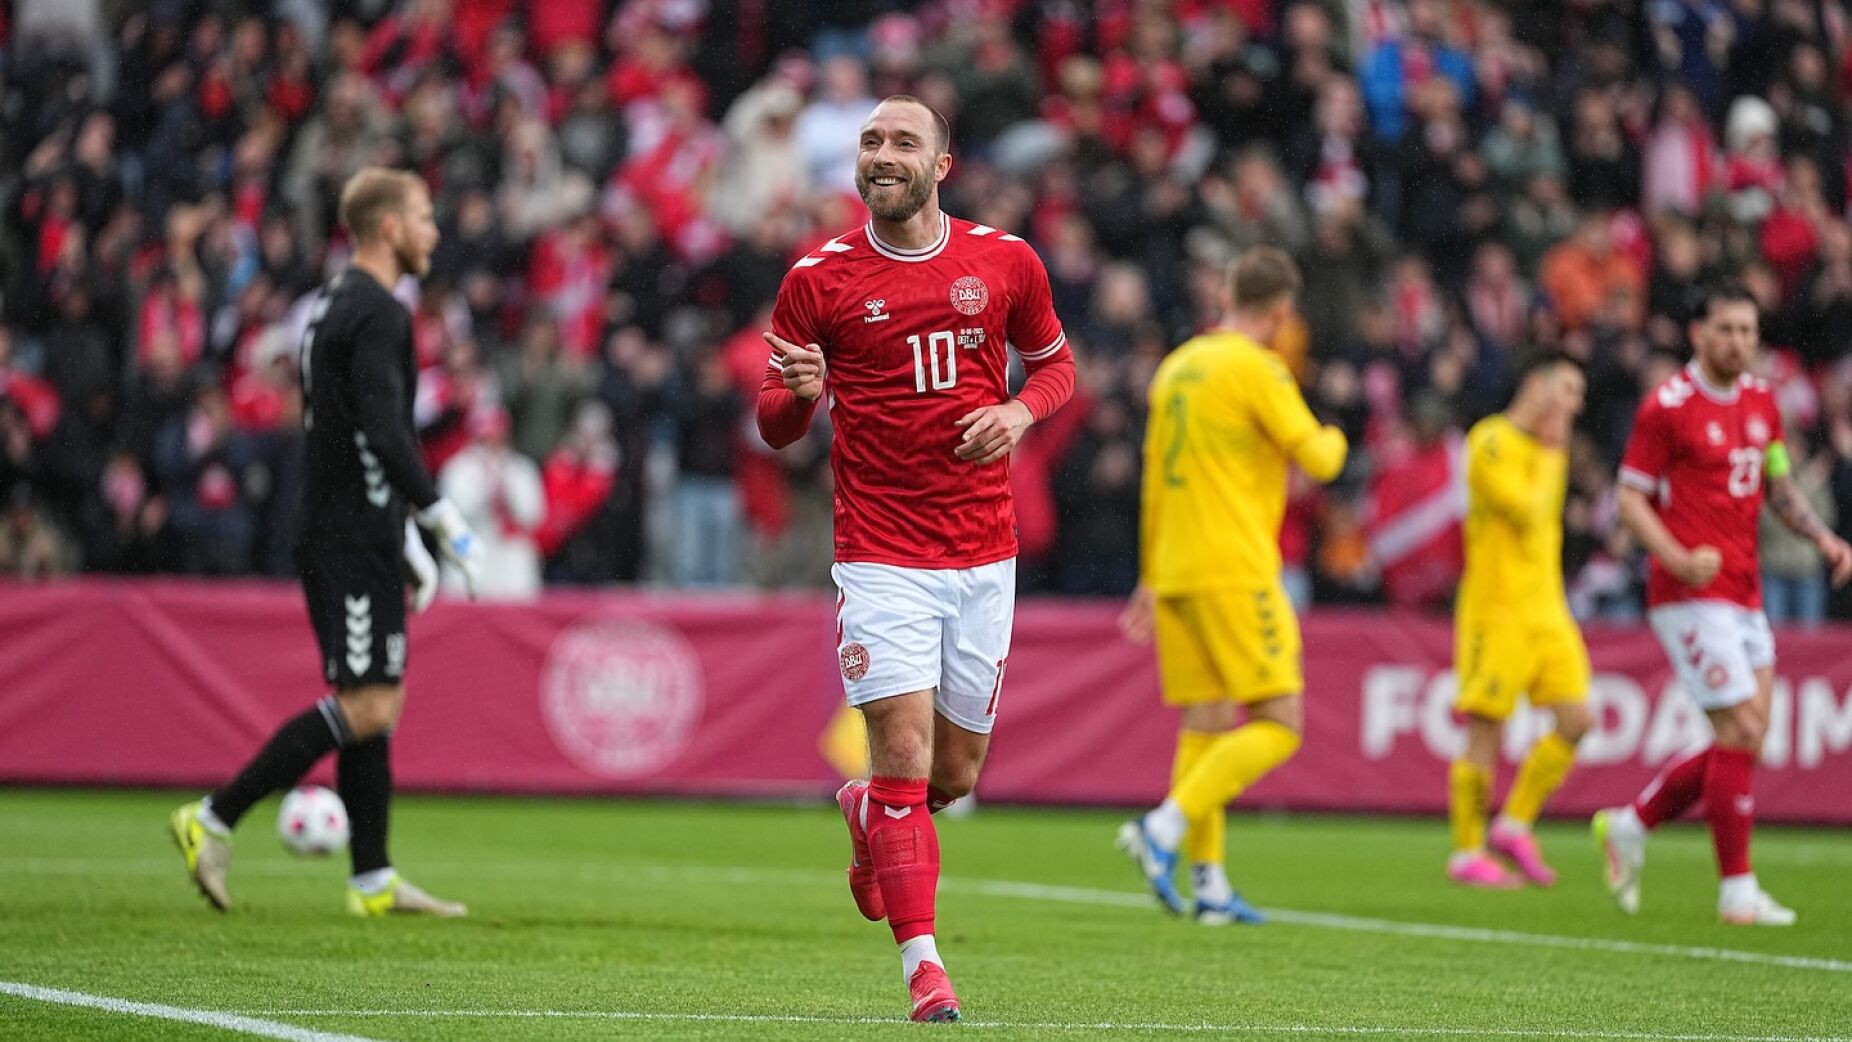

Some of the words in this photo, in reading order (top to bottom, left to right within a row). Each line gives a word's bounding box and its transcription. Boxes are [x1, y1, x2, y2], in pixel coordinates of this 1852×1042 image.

[959, 289, 981, 300] DBU
[907, 331, 957, 393] 10
[1728, 446, 1764, 498] 23
[985, 657, 1008, 716] 1
